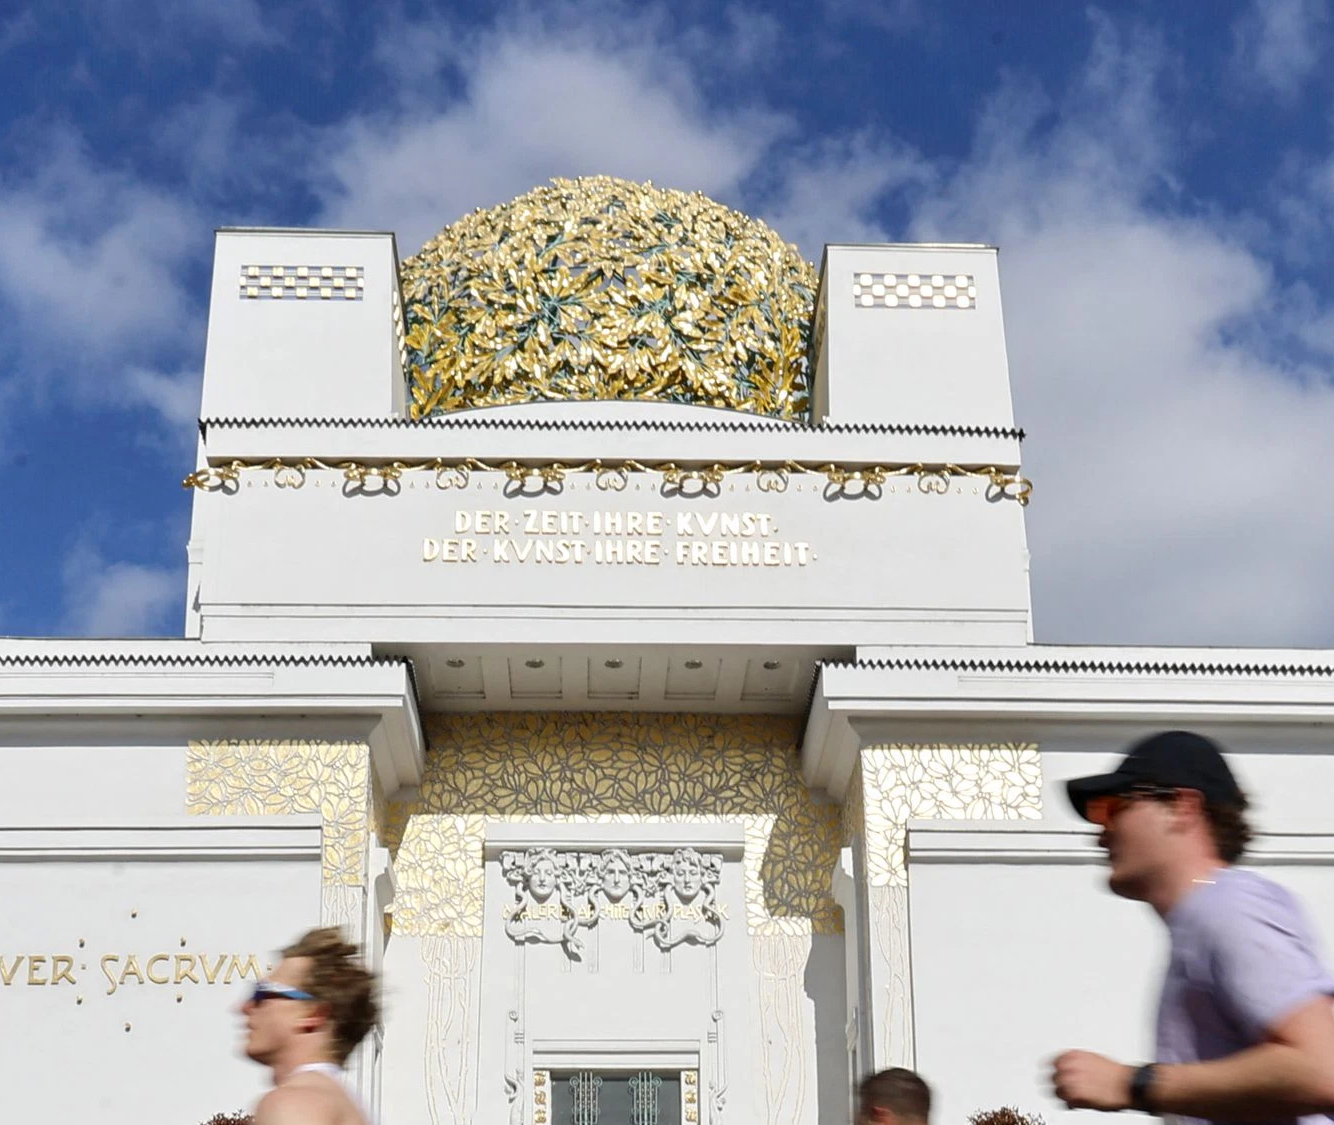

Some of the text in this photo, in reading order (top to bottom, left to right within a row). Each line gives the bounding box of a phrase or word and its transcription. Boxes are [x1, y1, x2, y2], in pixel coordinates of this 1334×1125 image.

[455, 510, 510, 534] DER
[523, 511, 584, 535] ZEIT
[593, 512, 663, 536] IHRE
[423, 538, 478, 563] DER
[595, 540, 661, 565] IHRE
[100, 954, 264, 995] SACRVM
